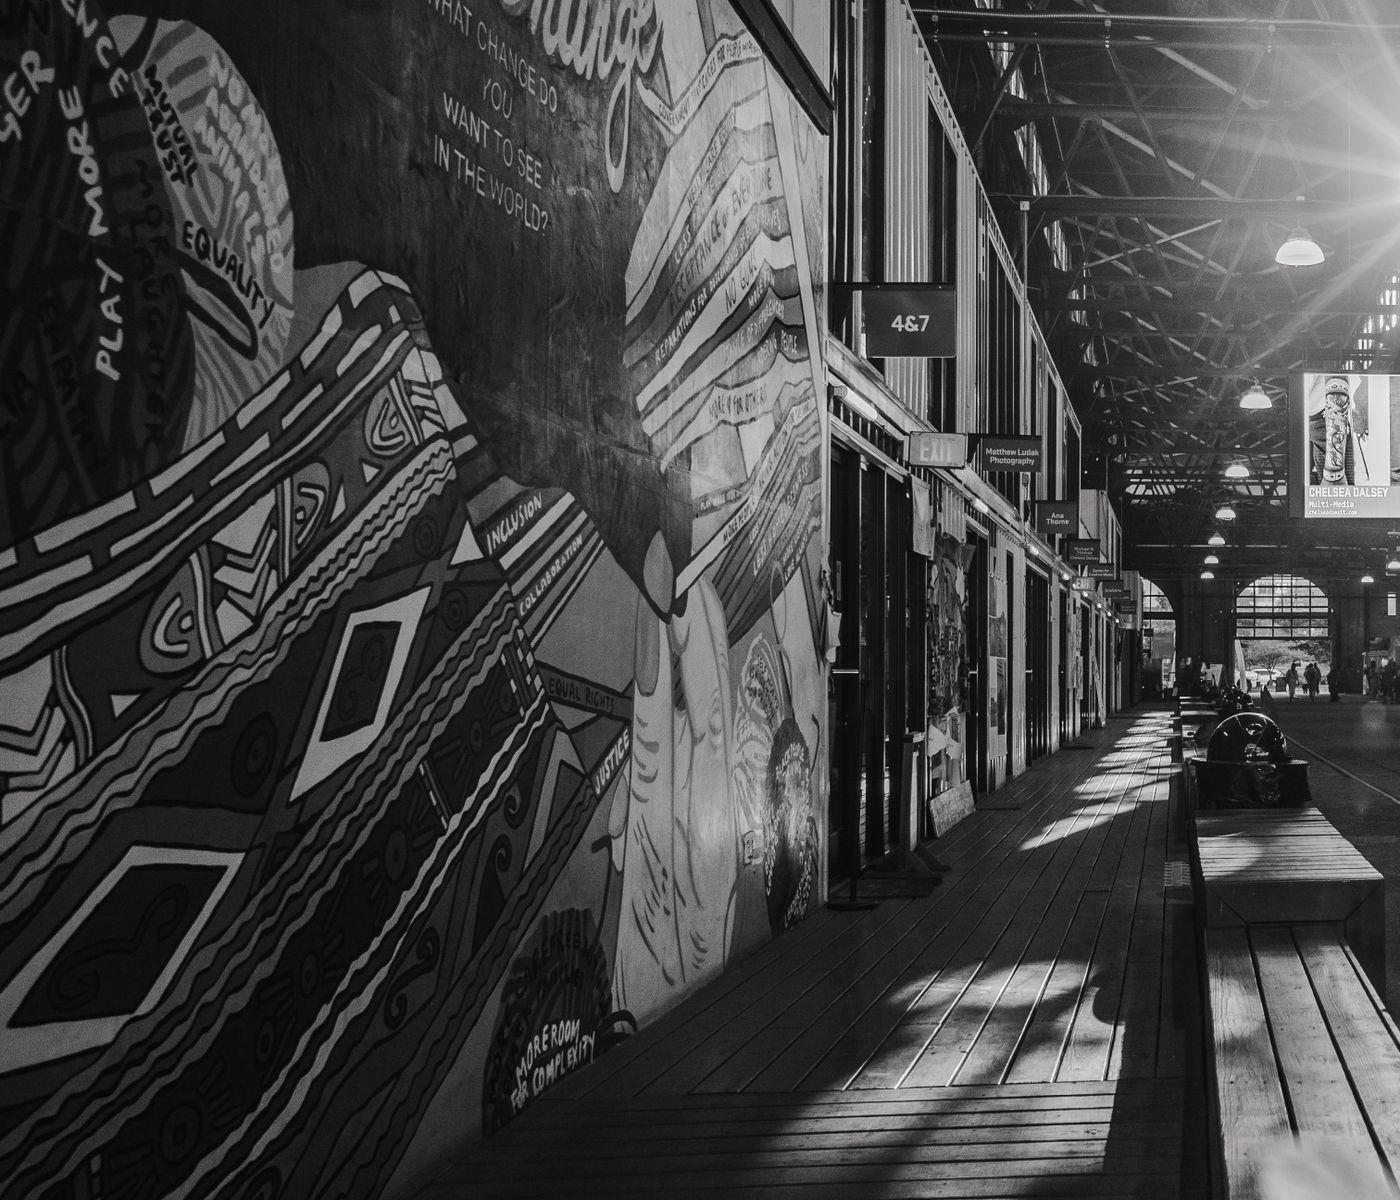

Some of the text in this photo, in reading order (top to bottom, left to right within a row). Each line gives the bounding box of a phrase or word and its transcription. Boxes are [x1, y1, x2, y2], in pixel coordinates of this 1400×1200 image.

[477, 21, 536, 96] CHANGE
[540, 77, 558, 112] DO
[483, 73, 513, 119] YOU
[143, 87, 187, 185] TRUST
[144, 63, 199, 188] MUTUAL
[443, 91, 542, 190] WANT TO SEE
[434, 134, 549, 237] IN THE WORLD?
[59, 84, 124, 381] PLAY MORE
[183, 220, 275, 329] EQUALITY
[724, 277, 737, 314] NO
[655, 298, 697, 366] REPARATIONS
[697, 287, 708, 311] FOR
[891, 314, 930, 332] 4&7
[918, 438, 952, 464] EXIT
[985, 446, 1040, 457] Matthew Ludak
[989, 456, 1036, 467] Photography
[486, 491, 543, 555] INCLUSION
[1046, 518, 1070, 526] Thorne
[1051, 512, 1065, 520] Ana
[1309, 487, 1388, 497] CHELSEA DALSEY
[1309, 500, 1355, 508] Multi-Media
[519, 533, 584, 617] COLLABORATION
[752, 536, 768, 577] LESS
[548, 677, 582, 702] EQUAL
[594, 728, 631, 796] JUSTICE
[510, 1077, 529, 1114] FOR
[532, 1030, 596, 1097] COMPLEXITY
[515, 1024, 549, 1090] MORE
[551, 1018, 580, 1050] ROOM
